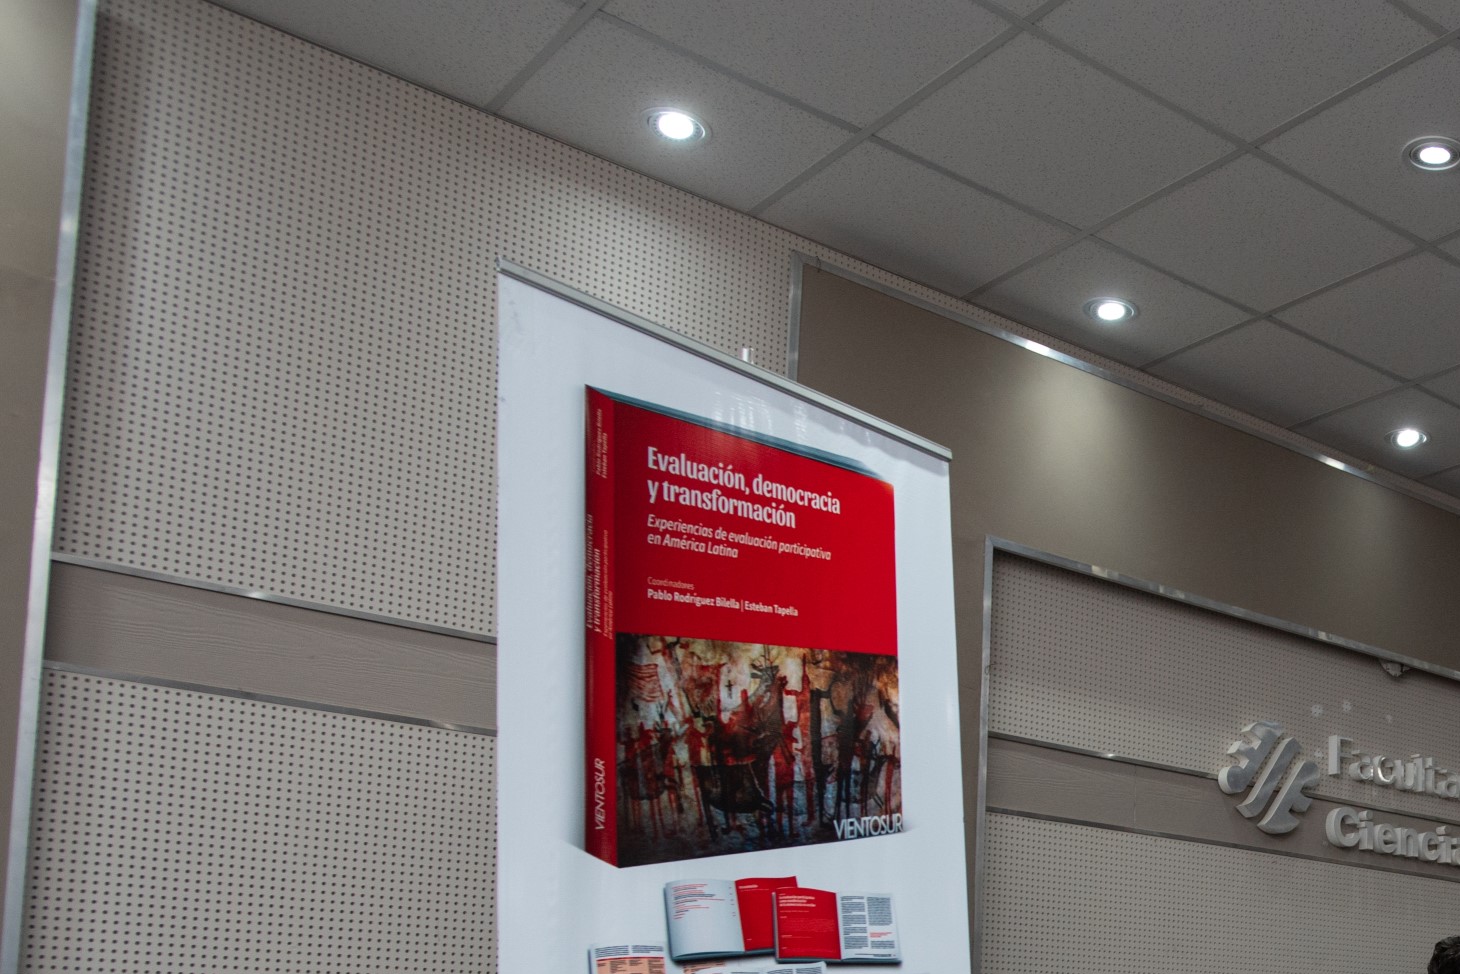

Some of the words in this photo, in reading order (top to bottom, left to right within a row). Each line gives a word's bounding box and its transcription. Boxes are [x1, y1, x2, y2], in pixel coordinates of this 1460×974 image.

[648, 446, 750, 495] Evaluación,
[752, 474, 840, 514] democracia
[647, 480, 659, 504] y
[662, 481, 796, 528] transformación
[647, 514, 713, 538] Experiencias
[714, 526, 728, 541] de
[728, 532, 778, 550] evaluación
[778, 542, 832, 560] participativa
[647, 533, 662, 545] en
[662, 534, 706, 553] América
[707, 541, 739, 558] Latina
[647, 576, 695, 590] Coordinadores
[647, 588, 673, 601] Pablo
[673, 591, 715, 607] Rodríguez
[715, 596, 740, 609] Bilella
[744, 600, 774, 613] Esteban
[773, 604, 798, 617] Tapella
[594, 757, 606, 830] VIENTOSUR
[833, 813, 904, 840] VIENTOSUR
